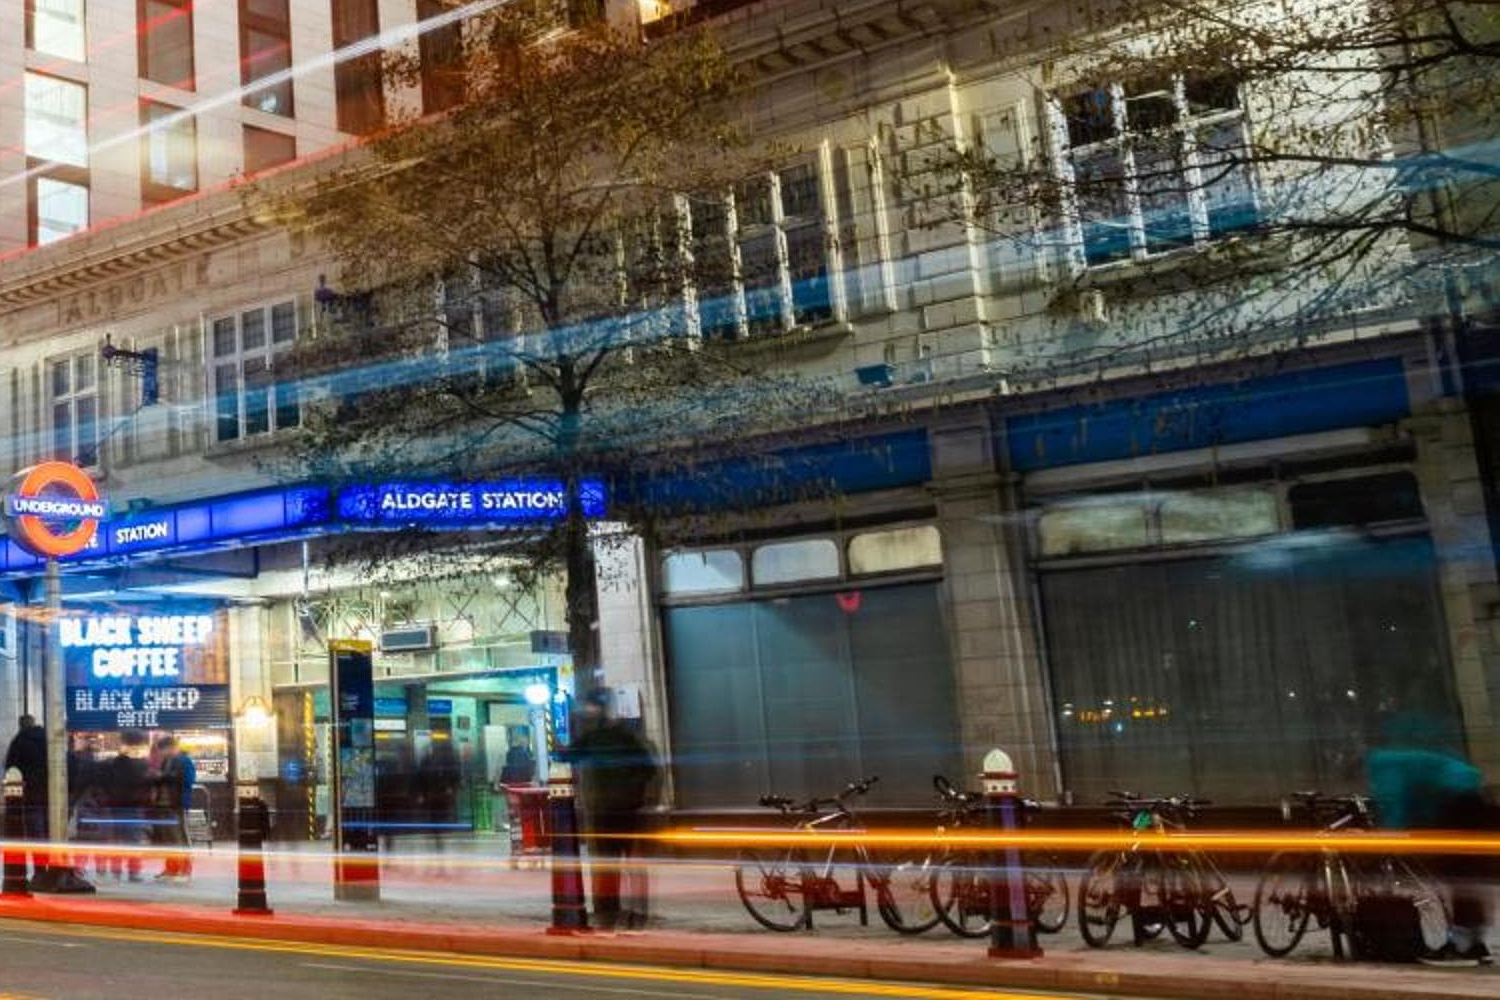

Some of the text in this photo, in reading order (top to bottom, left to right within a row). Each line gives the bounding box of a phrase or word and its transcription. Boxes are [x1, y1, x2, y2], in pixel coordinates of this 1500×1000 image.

[13, 499, 103, 517] UNDERGROUND
[381, 491, 563, 510] ALDGATE STATION
[116, 521, 168, 544] STATION
[59, 615, 213, 647] BLACK SHEEP
[92, 647, 180, 678] COFFEE
[75, 688, 201, 711] BLACK SHEEP
[117, 711, 159, 727] COFFEE
